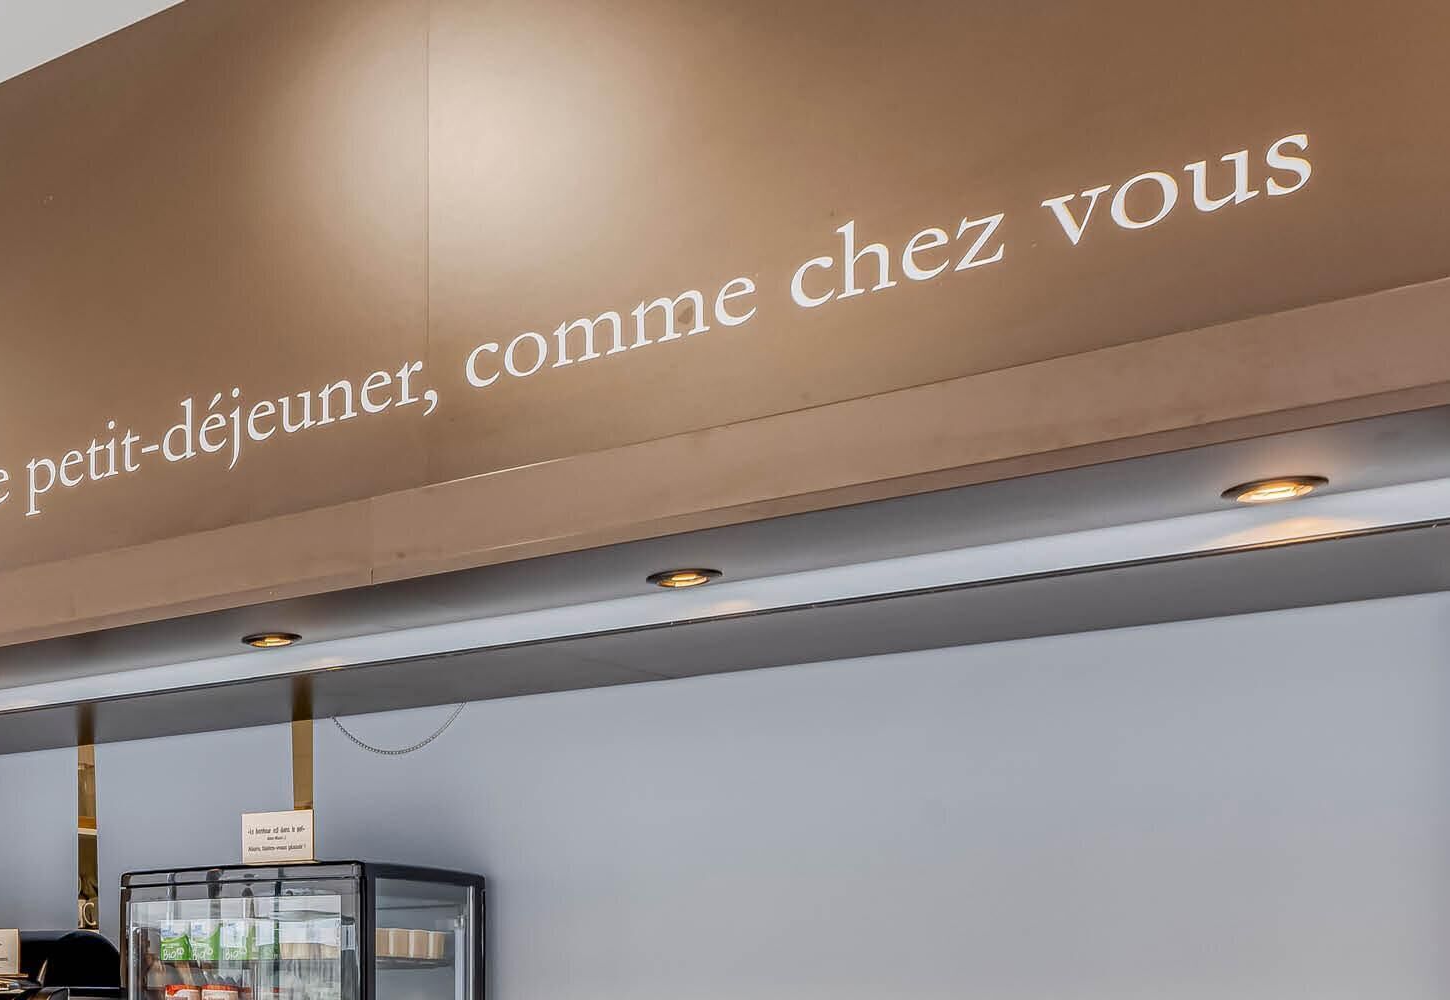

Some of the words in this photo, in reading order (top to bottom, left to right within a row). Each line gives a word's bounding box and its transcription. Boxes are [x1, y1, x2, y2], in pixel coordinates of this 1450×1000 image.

[25, 360, 439, 517] petit-déjeuner,
[465, 277, 756, 388] comme
[791, 213, 1005, 308] chez
[1040, 134, 1313, 246] vous
